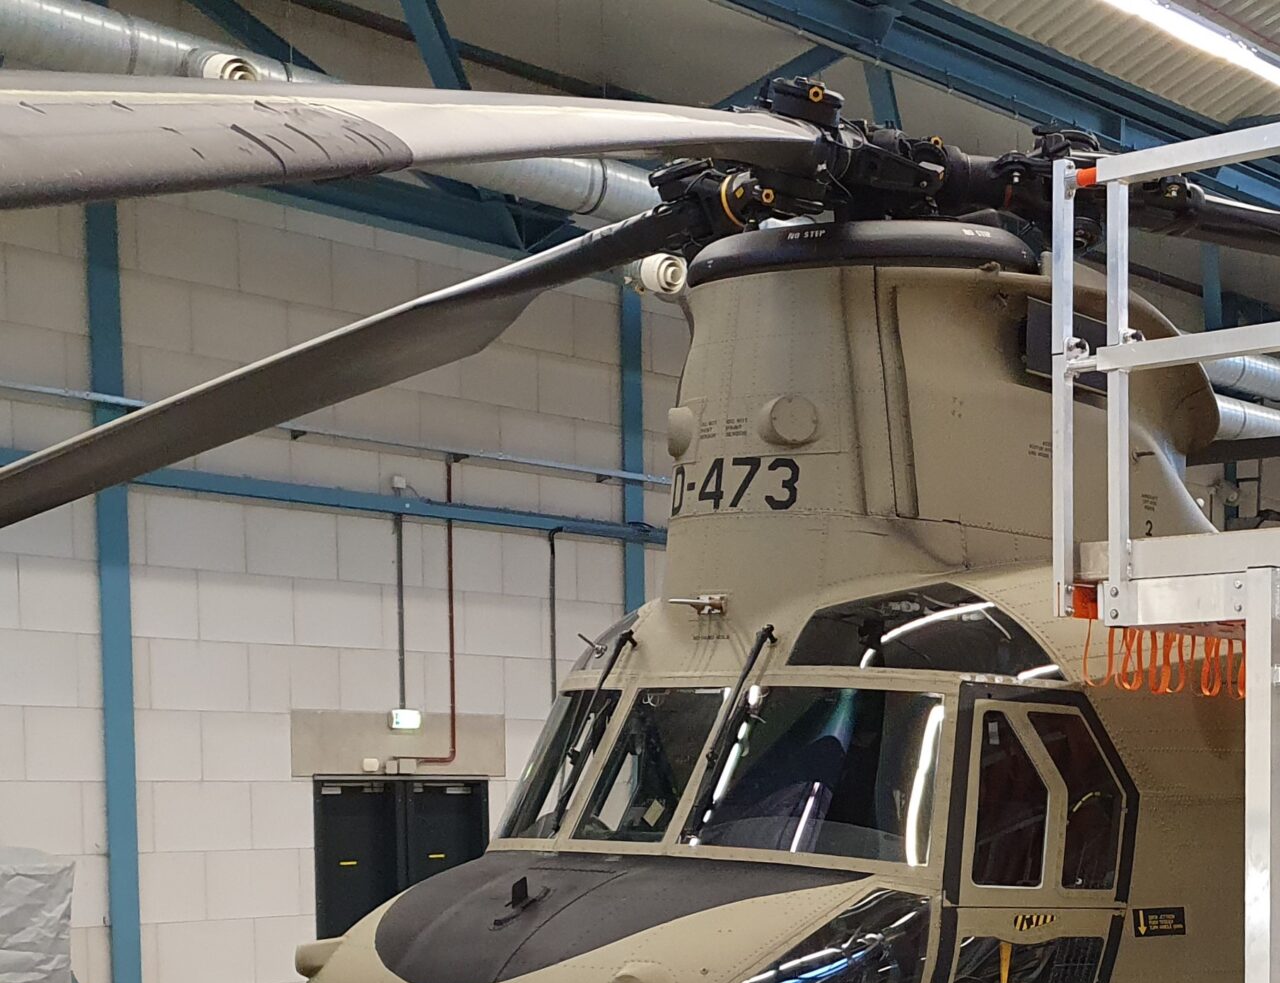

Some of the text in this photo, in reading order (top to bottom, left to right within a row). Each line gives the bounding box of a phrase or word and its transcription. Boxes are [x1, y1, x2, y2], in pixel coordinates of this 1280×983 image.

[787, 229, 826, 240] NO STEP
[1144, 520, 1153, 537] 2
